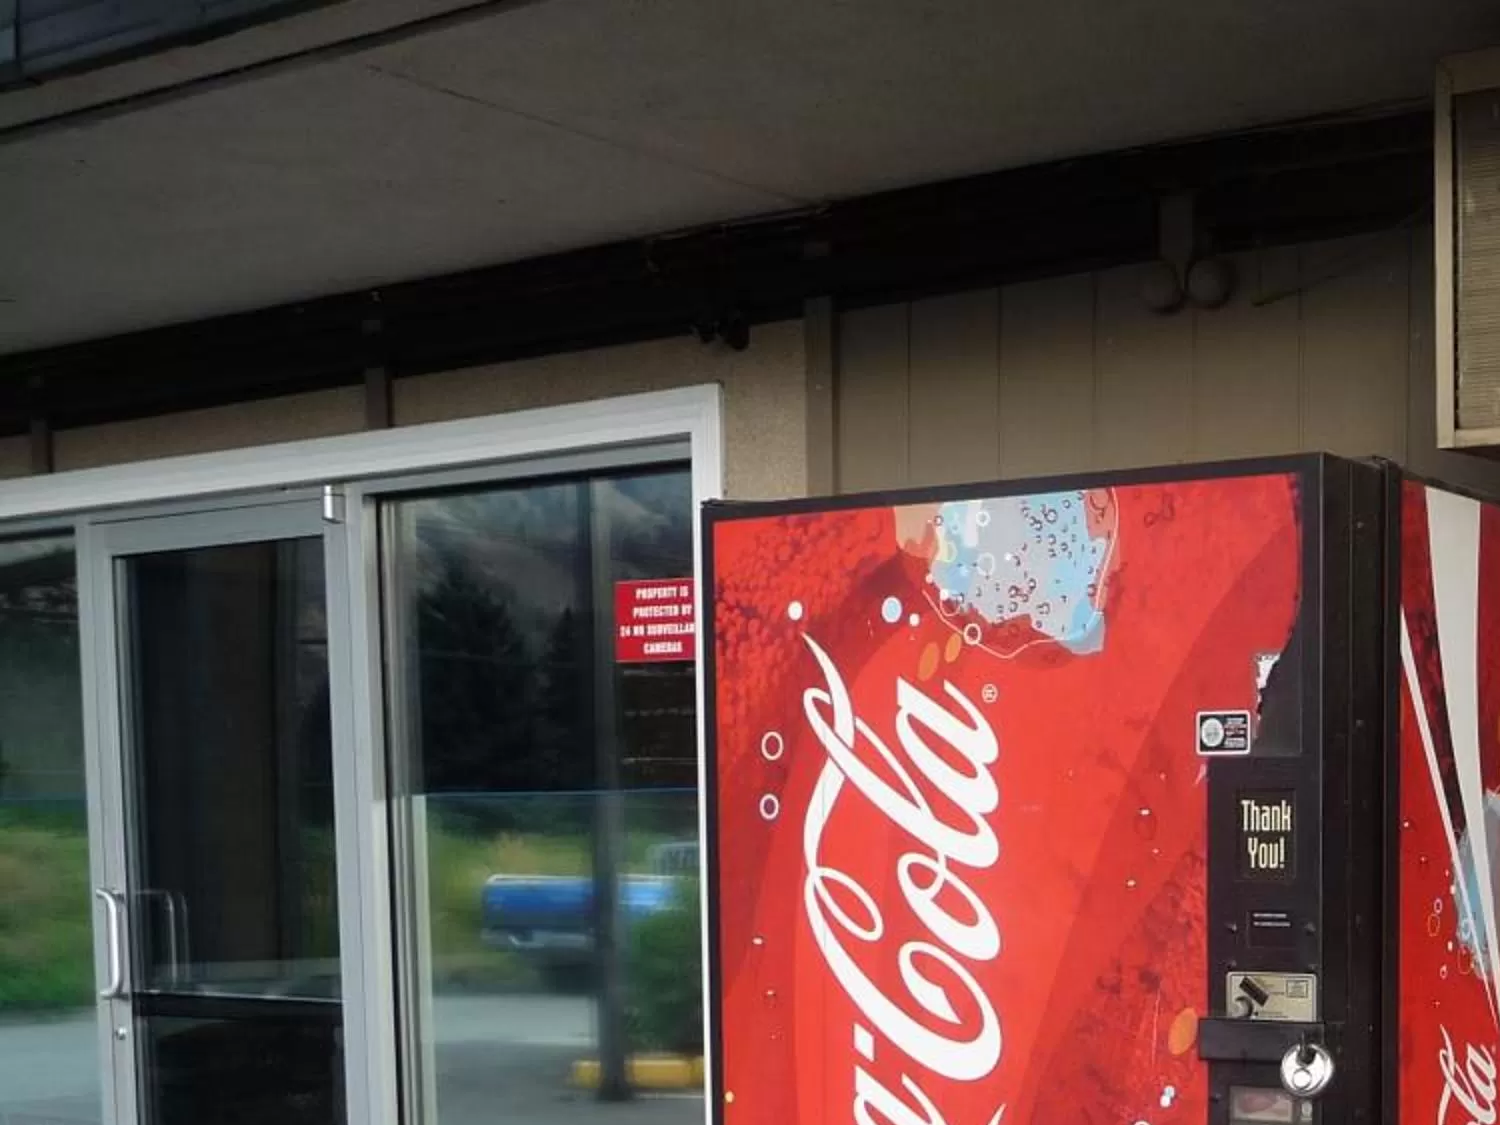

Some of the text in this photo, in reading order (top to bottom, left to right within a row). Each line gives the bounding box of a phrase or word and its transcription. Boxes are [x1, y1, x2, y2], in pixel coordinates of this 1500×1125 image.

[635, 585, 689, 600] PROPERTY IS
[633, 603, 692, 618] PROTECTED BY
[620, 625, 631, 637] 24
[643, 641, 683, 654] CAMERAS
[1240, 799, 1292, 832] Thank
[1247, 836, 1286, 869] You!
